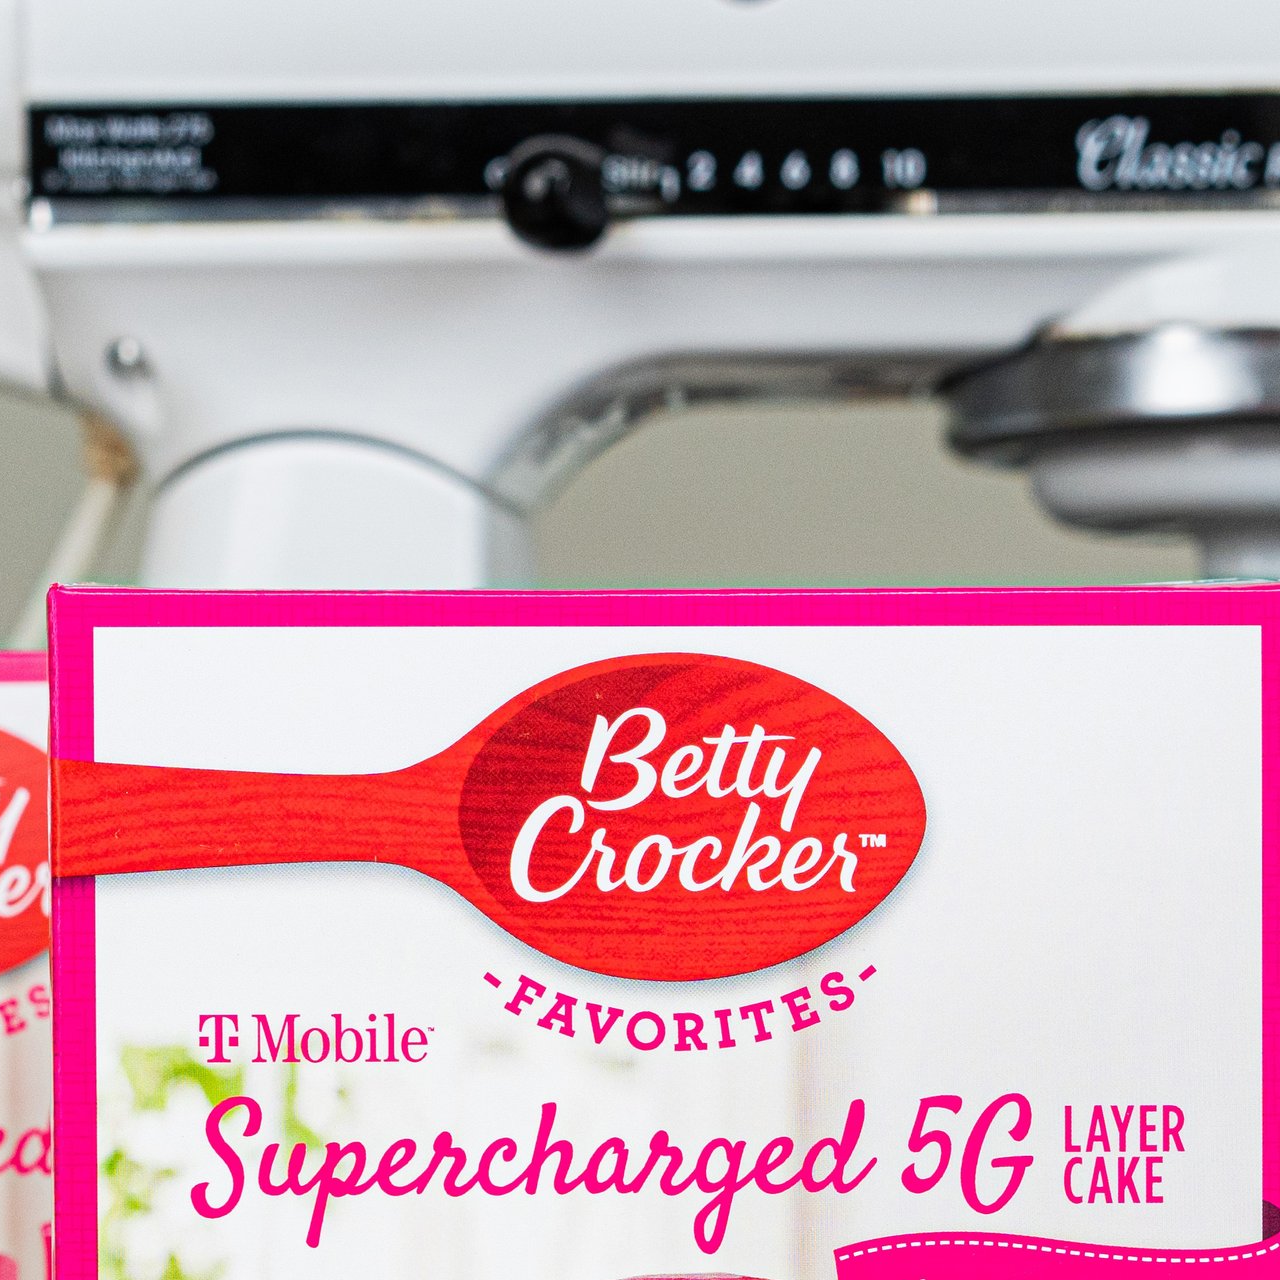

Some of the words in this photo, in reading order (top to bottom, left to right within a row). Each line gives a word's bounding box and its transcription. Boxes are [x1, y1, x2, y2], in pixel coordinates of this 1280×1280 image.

[687, 150, 717, 191] 2
[733, 149, 764, 190] 4
[780, 149, 811, 190] 6
[829, 148, 859, 190] 8
[882, 148, 927, 189] 10
[1077, 114, 1264, 191] Classic
[580, 707, 822, 832] Betty
[1064, 1105, 1186, 1152] LAYER
[191, 1095, 878, 1254] Supercharged
[901, 1092, 1034, 1215] 5G
[1064, 1156, 1164, 1204] CAKE
